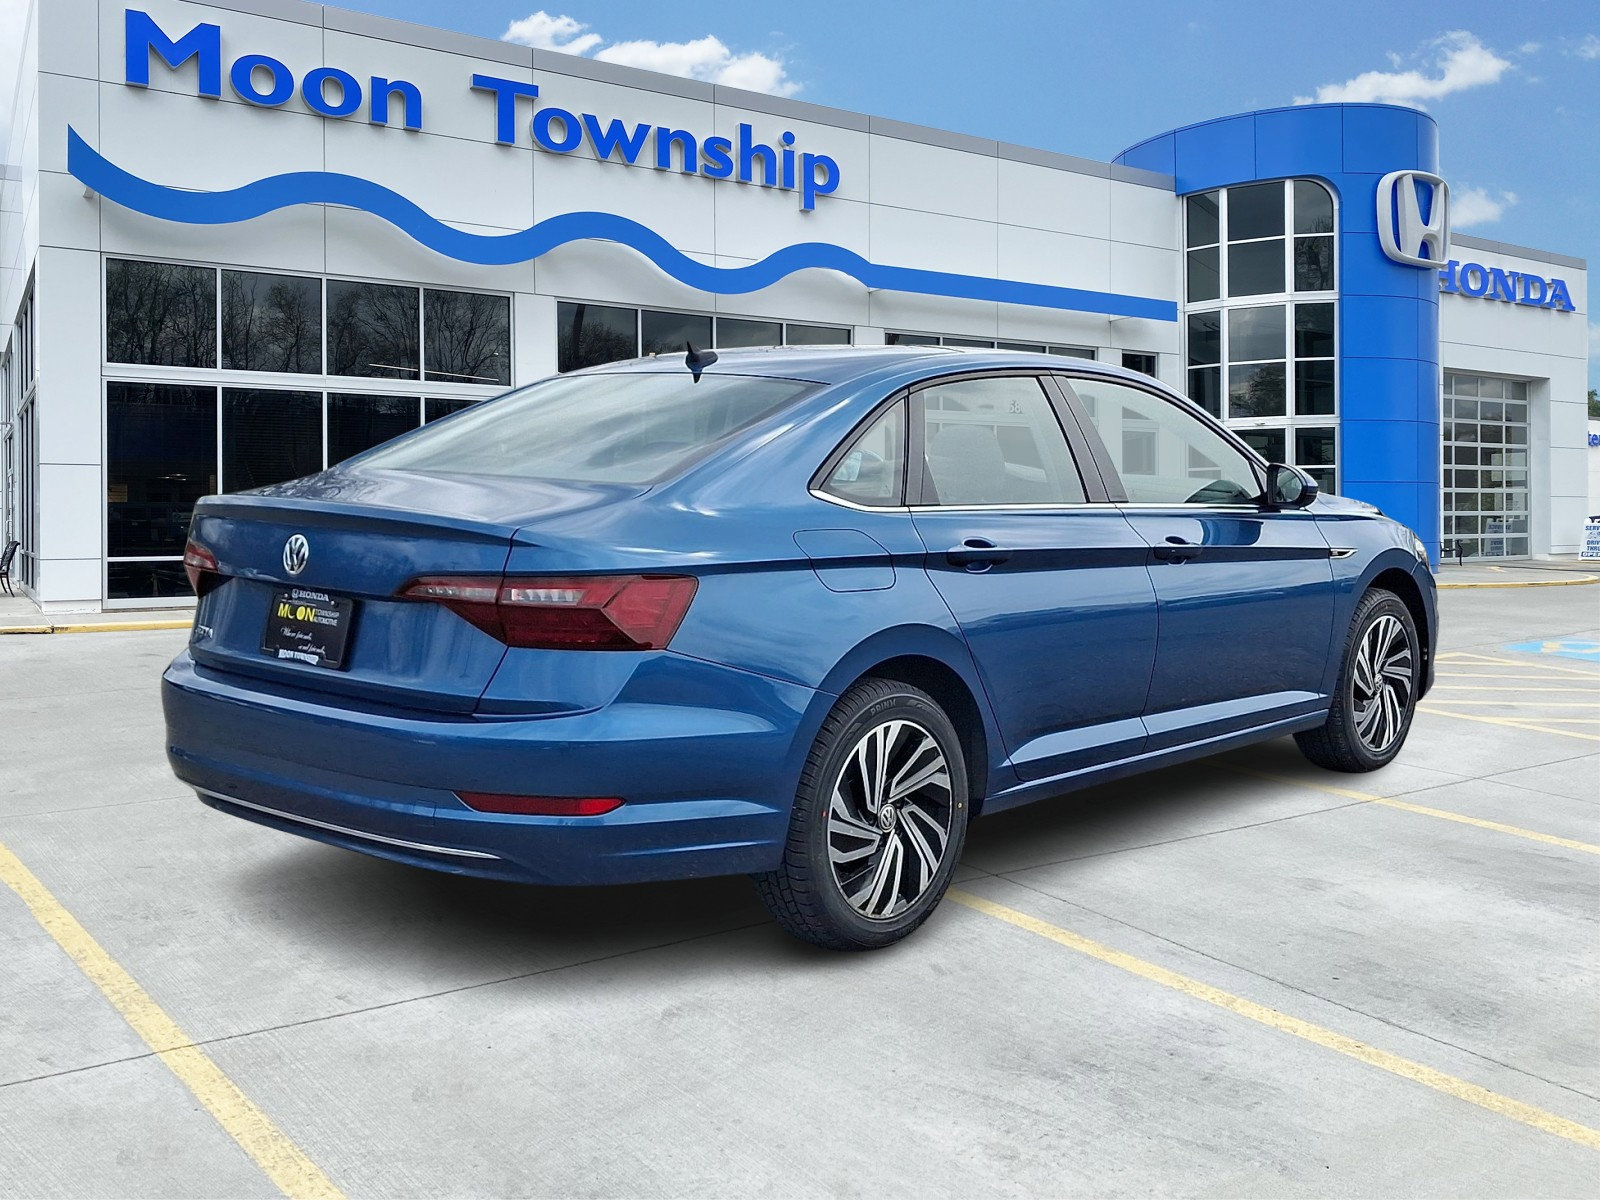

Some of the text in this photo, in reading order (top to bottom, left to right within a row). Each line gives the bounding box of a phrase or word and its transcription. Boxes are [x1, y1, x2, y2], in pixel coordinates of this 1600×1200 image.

[125, 9, 841, 212] Moon Township
[1438, 259, 1576, 312] HONDA
[299, 591, 329, 602] HONDA
